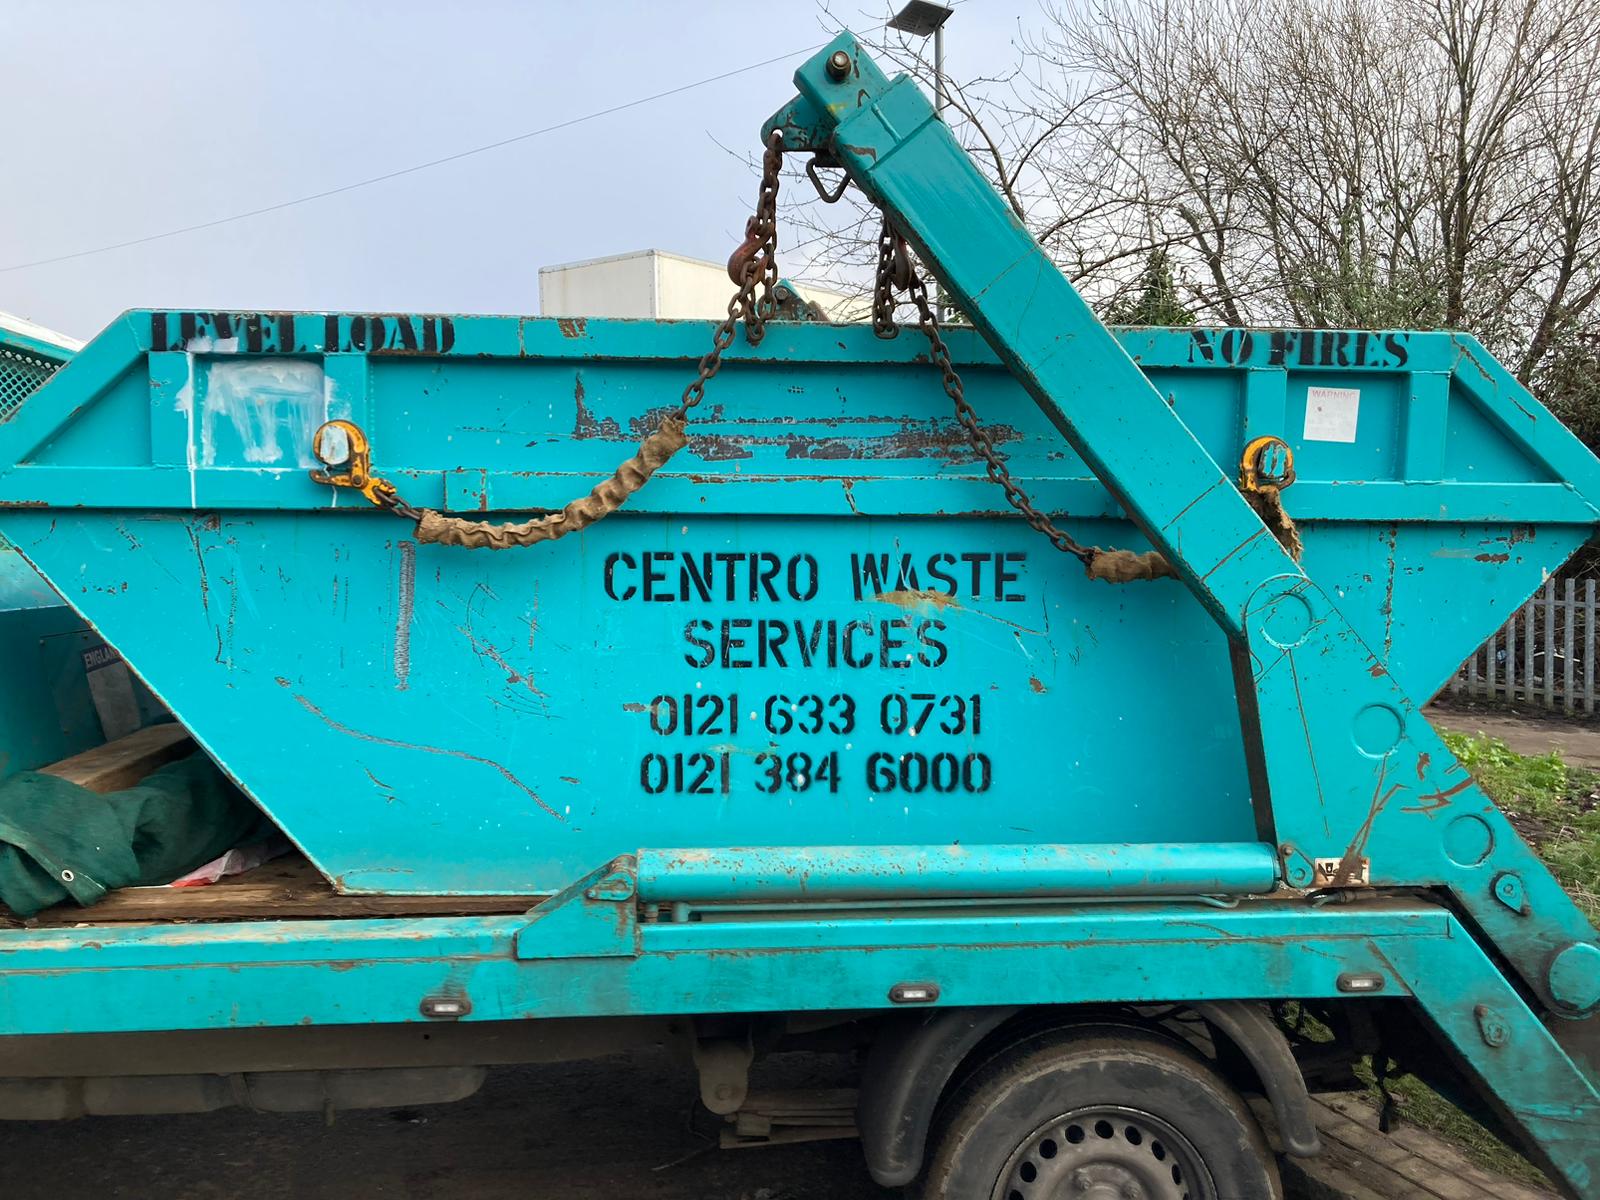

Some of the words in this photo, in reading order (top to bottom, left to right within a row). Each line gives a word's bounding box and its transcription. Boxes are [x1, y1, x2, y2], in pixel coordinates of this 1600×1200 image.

[151, 312, 307, 352] LEVEL
[324, 314, 455, 353] LOAD
[1187, 329, 1254, 364] NO
[1268, 331, 1410, 367] FIRES
[1312, 390, 1356, 400] WARNING
[603, 551, 819, 602] CENTRO
[850, 551, 1027, 602] WASTE
[683, 618, 948, 669] SERVICES
[650, 693, 738, 736] 0121
[764, 693, 857, 735] 633
[880, 693, 981, 735] 0731
[640, 751, 730, 794] 0121
[754, 751, 841, 794] 384
[866, 751, 992, 794] 6000
